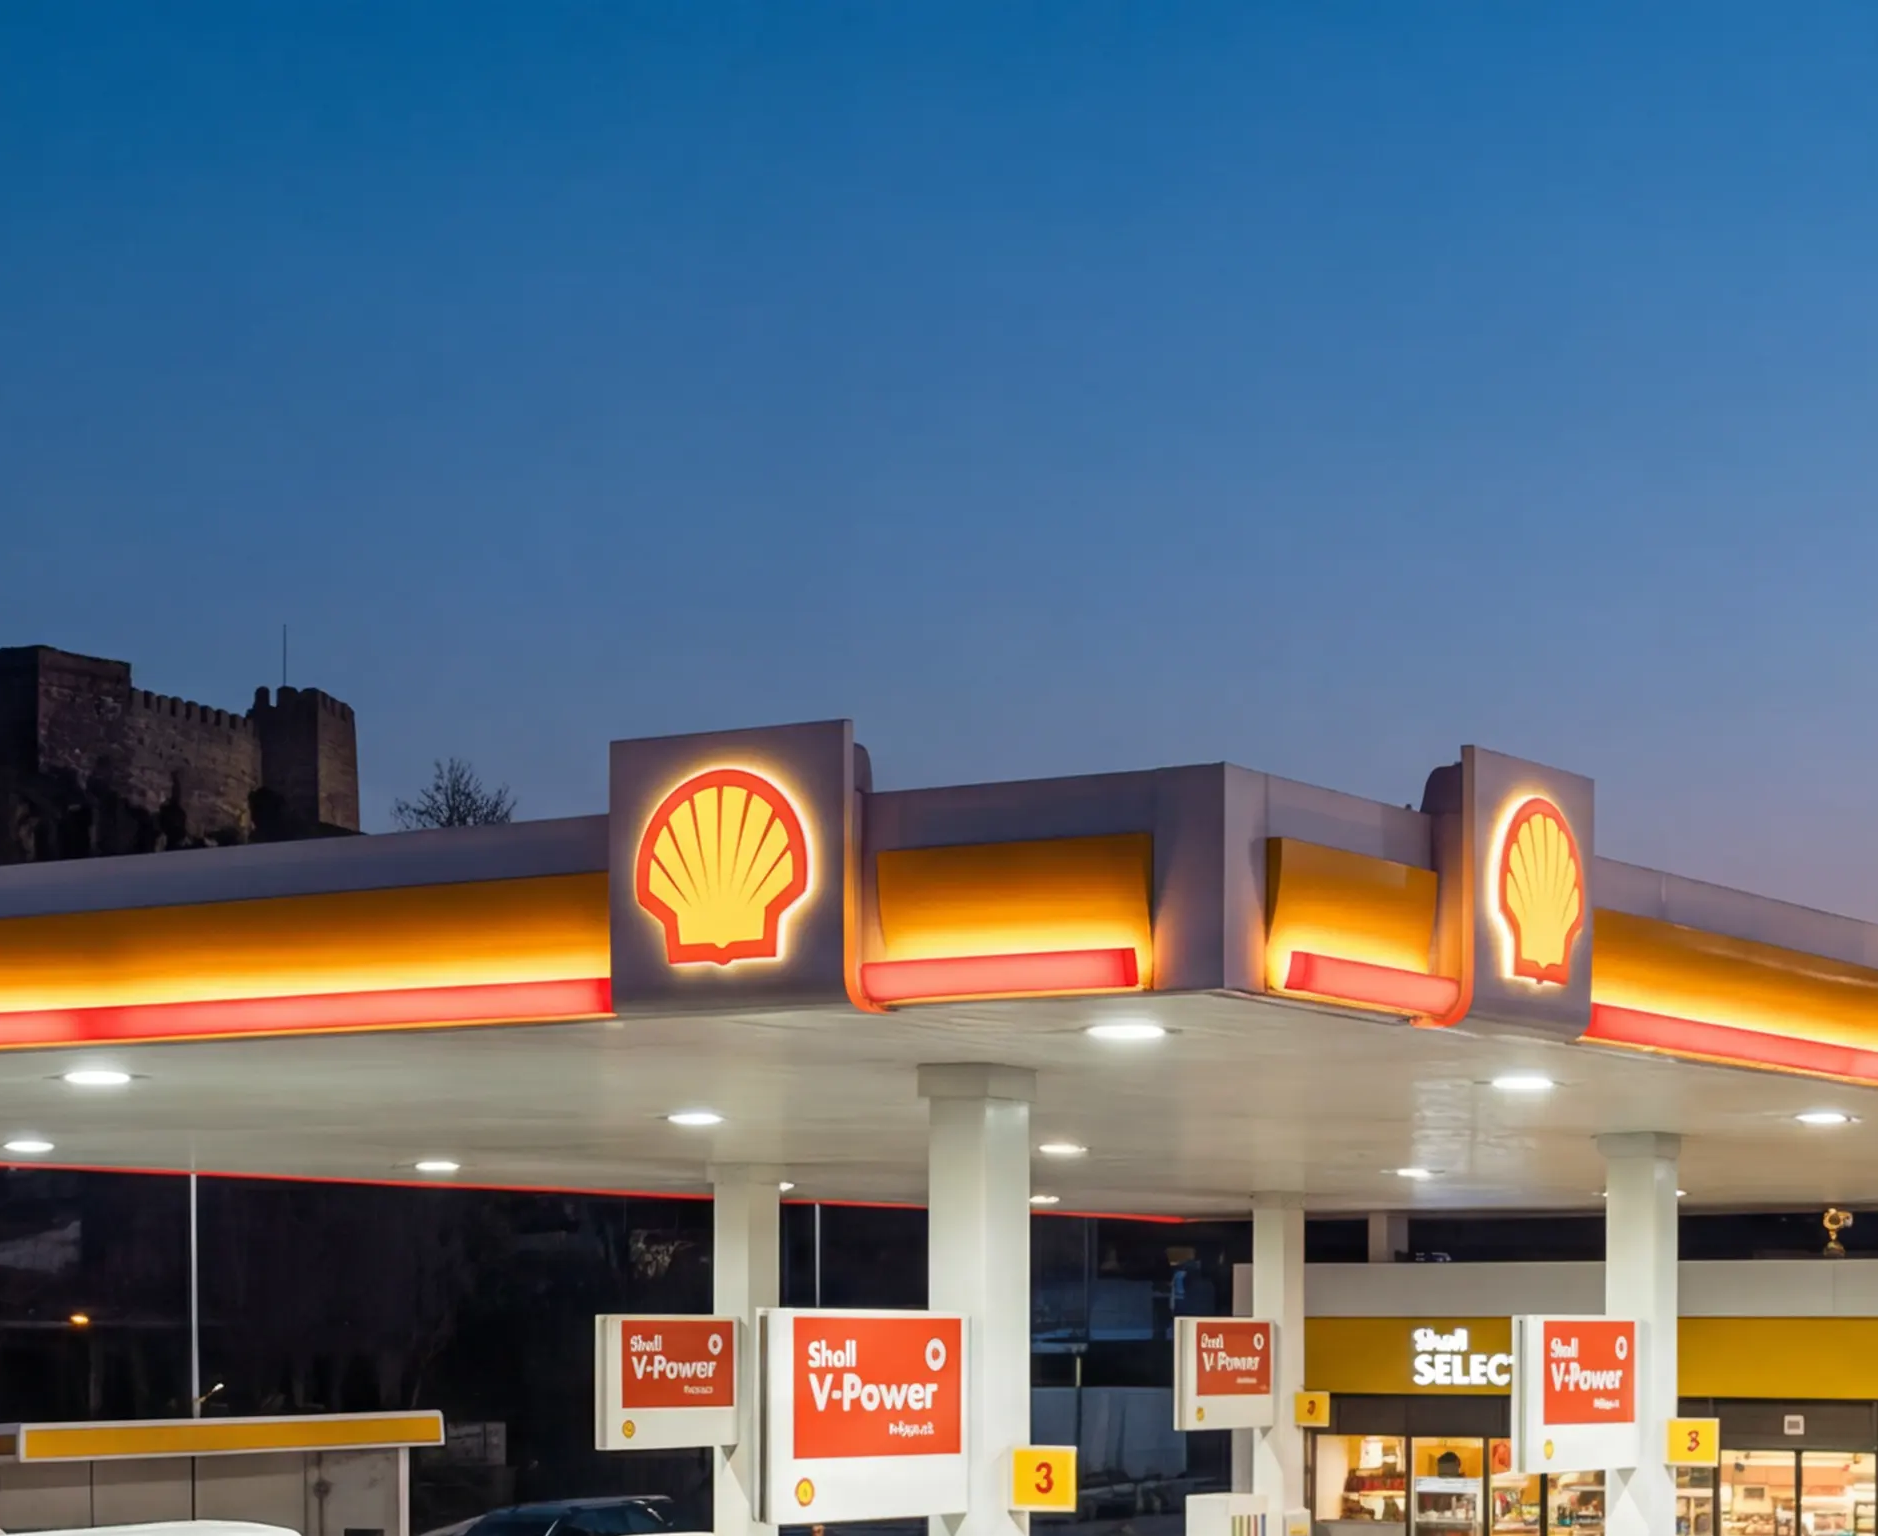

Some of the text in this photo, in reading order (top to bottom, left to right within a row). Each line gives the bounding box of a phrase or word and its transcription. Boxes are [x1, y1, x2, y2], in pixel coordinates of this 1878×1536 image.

[1413, 1353, 1515, 1386] SELEC
[808, 1372, 938, 1411] V-Power
[1034, 1461, 1054, 1494] 3
